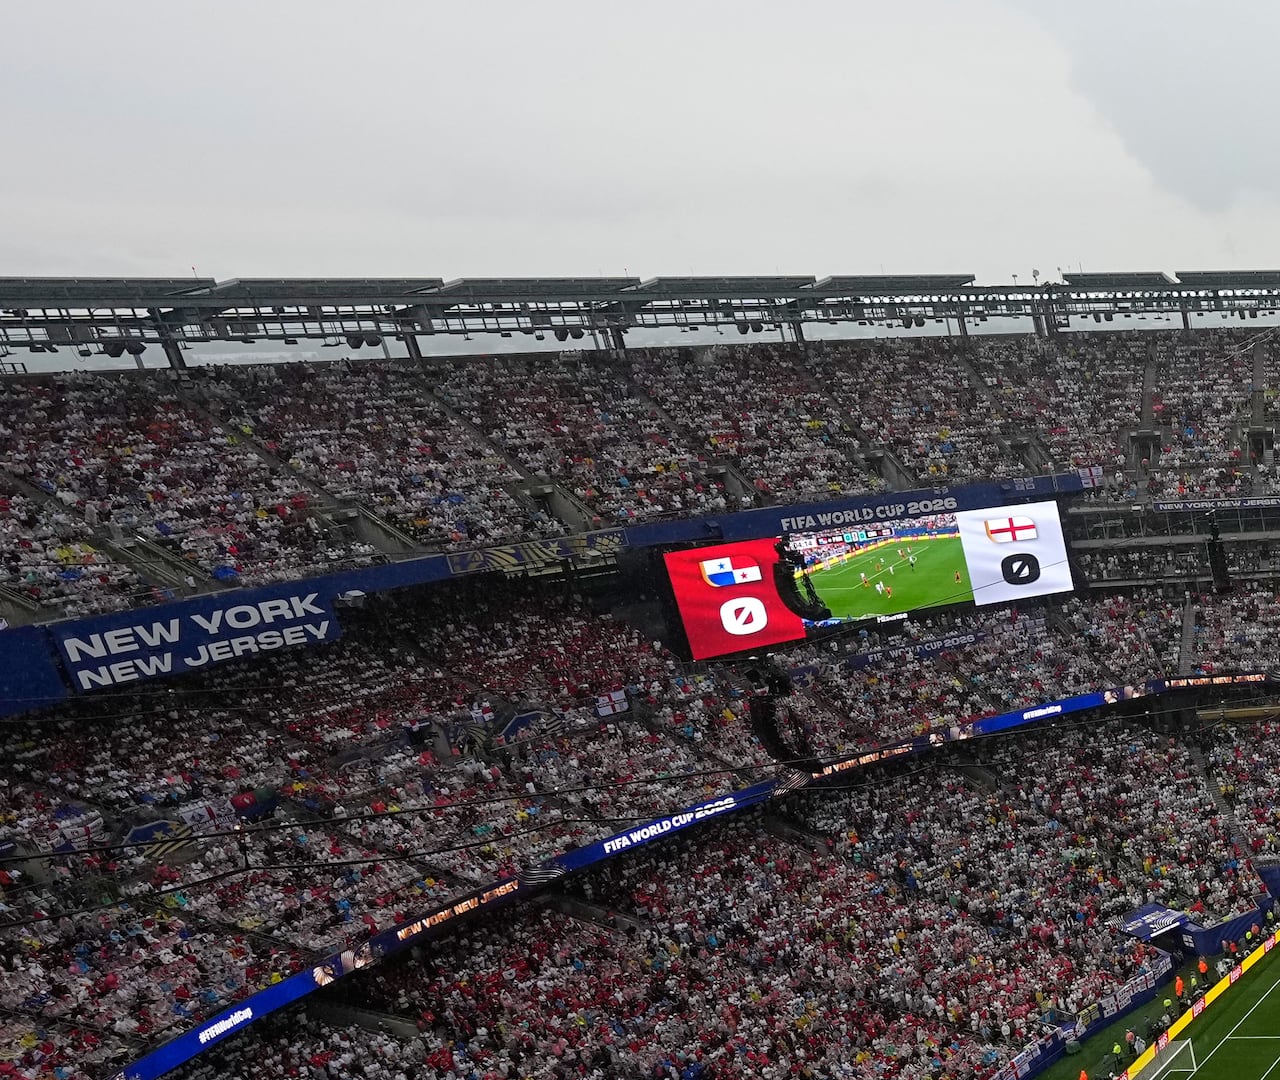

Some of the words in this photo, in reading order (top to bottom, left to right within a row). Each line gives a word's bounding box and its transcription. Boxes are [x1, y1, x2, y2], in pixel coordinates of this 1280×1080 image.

[781, 516, 816, 531] FIFA
[817, 508, 875, 525] WORLD
[876, 504, 905, 519] CUP
[908, 497, 958, 514] 2026
[64, 619, 180, 662] NEW
[190, 593, 325, 635] YORK
[877, 612, 908, 623] Hisense
[77, 652, 172, 690] NEW
[183, 621, 330, 666] JERSEY
[925, 641, 943, 652] CUP
[944, 635, 975, 647] 2026
[1188, 677, 1211, 686] YORK
[1213, 676, 1232, 685] NEW
[1233, 674, 1266, 684] JERSEY
[833, 758, 859, 772] YORK
[859, 752, 880, 764] NEW
[604, 836, 631, 854] FIFA
[629, 820, 672, 843] WORLD
[672, 812, 694, 828] CUP
[694, 797, 737, 819] 2026
[397, 921, 423, 941] NEW
[422, 909, 454, 929] YORK
[454, 896, 479, 915] NEW
[480, 879, 519, 904] JERSEY
[199, 1007, 253, 1044] #FIFAWorldCup
